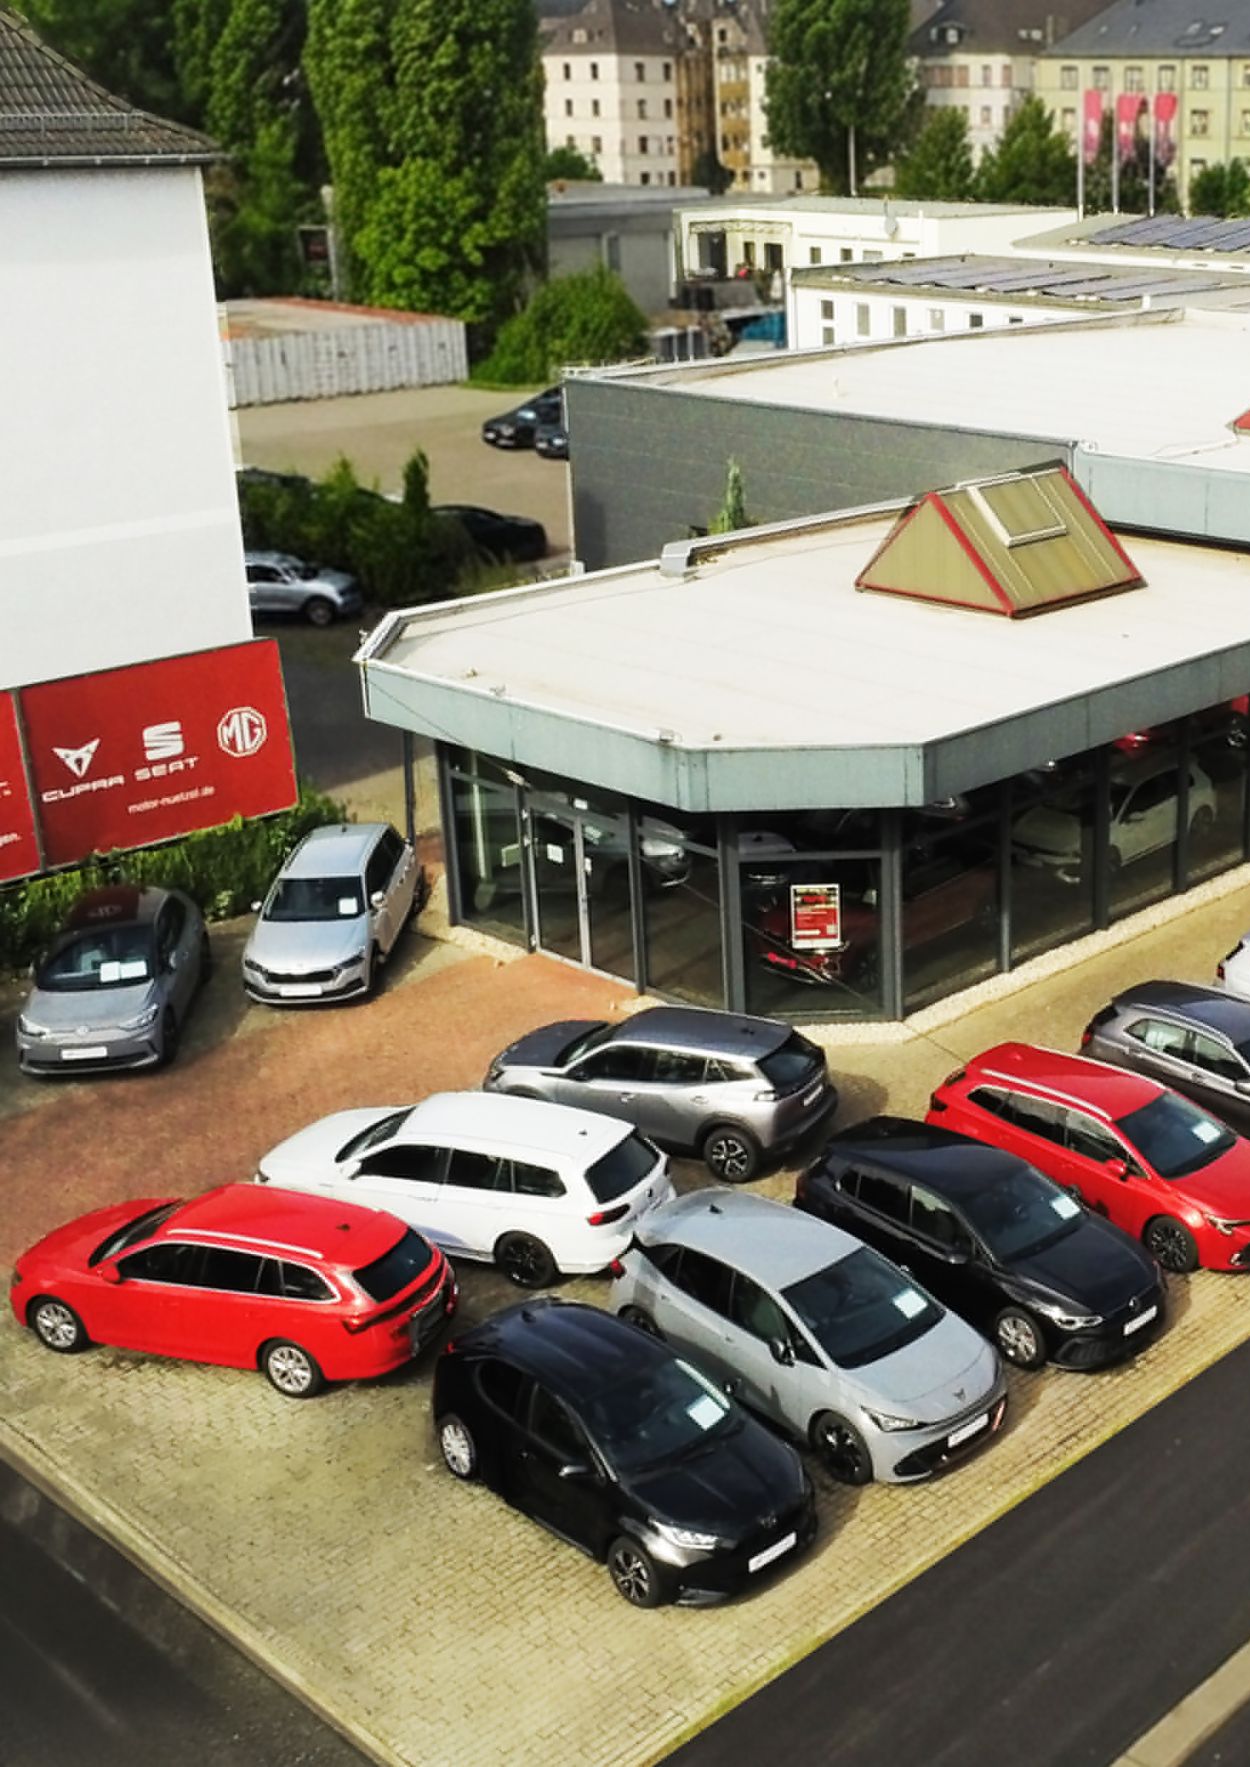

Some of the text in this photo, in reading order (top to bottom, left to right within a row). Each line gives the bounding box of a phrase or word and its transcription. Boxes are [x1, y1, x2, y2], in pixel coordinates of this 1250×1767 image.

[219, 709, 266, 755] MG
[42, 774, 125, 803] CUPRA
[135, 756, 198, 781] SEAT
